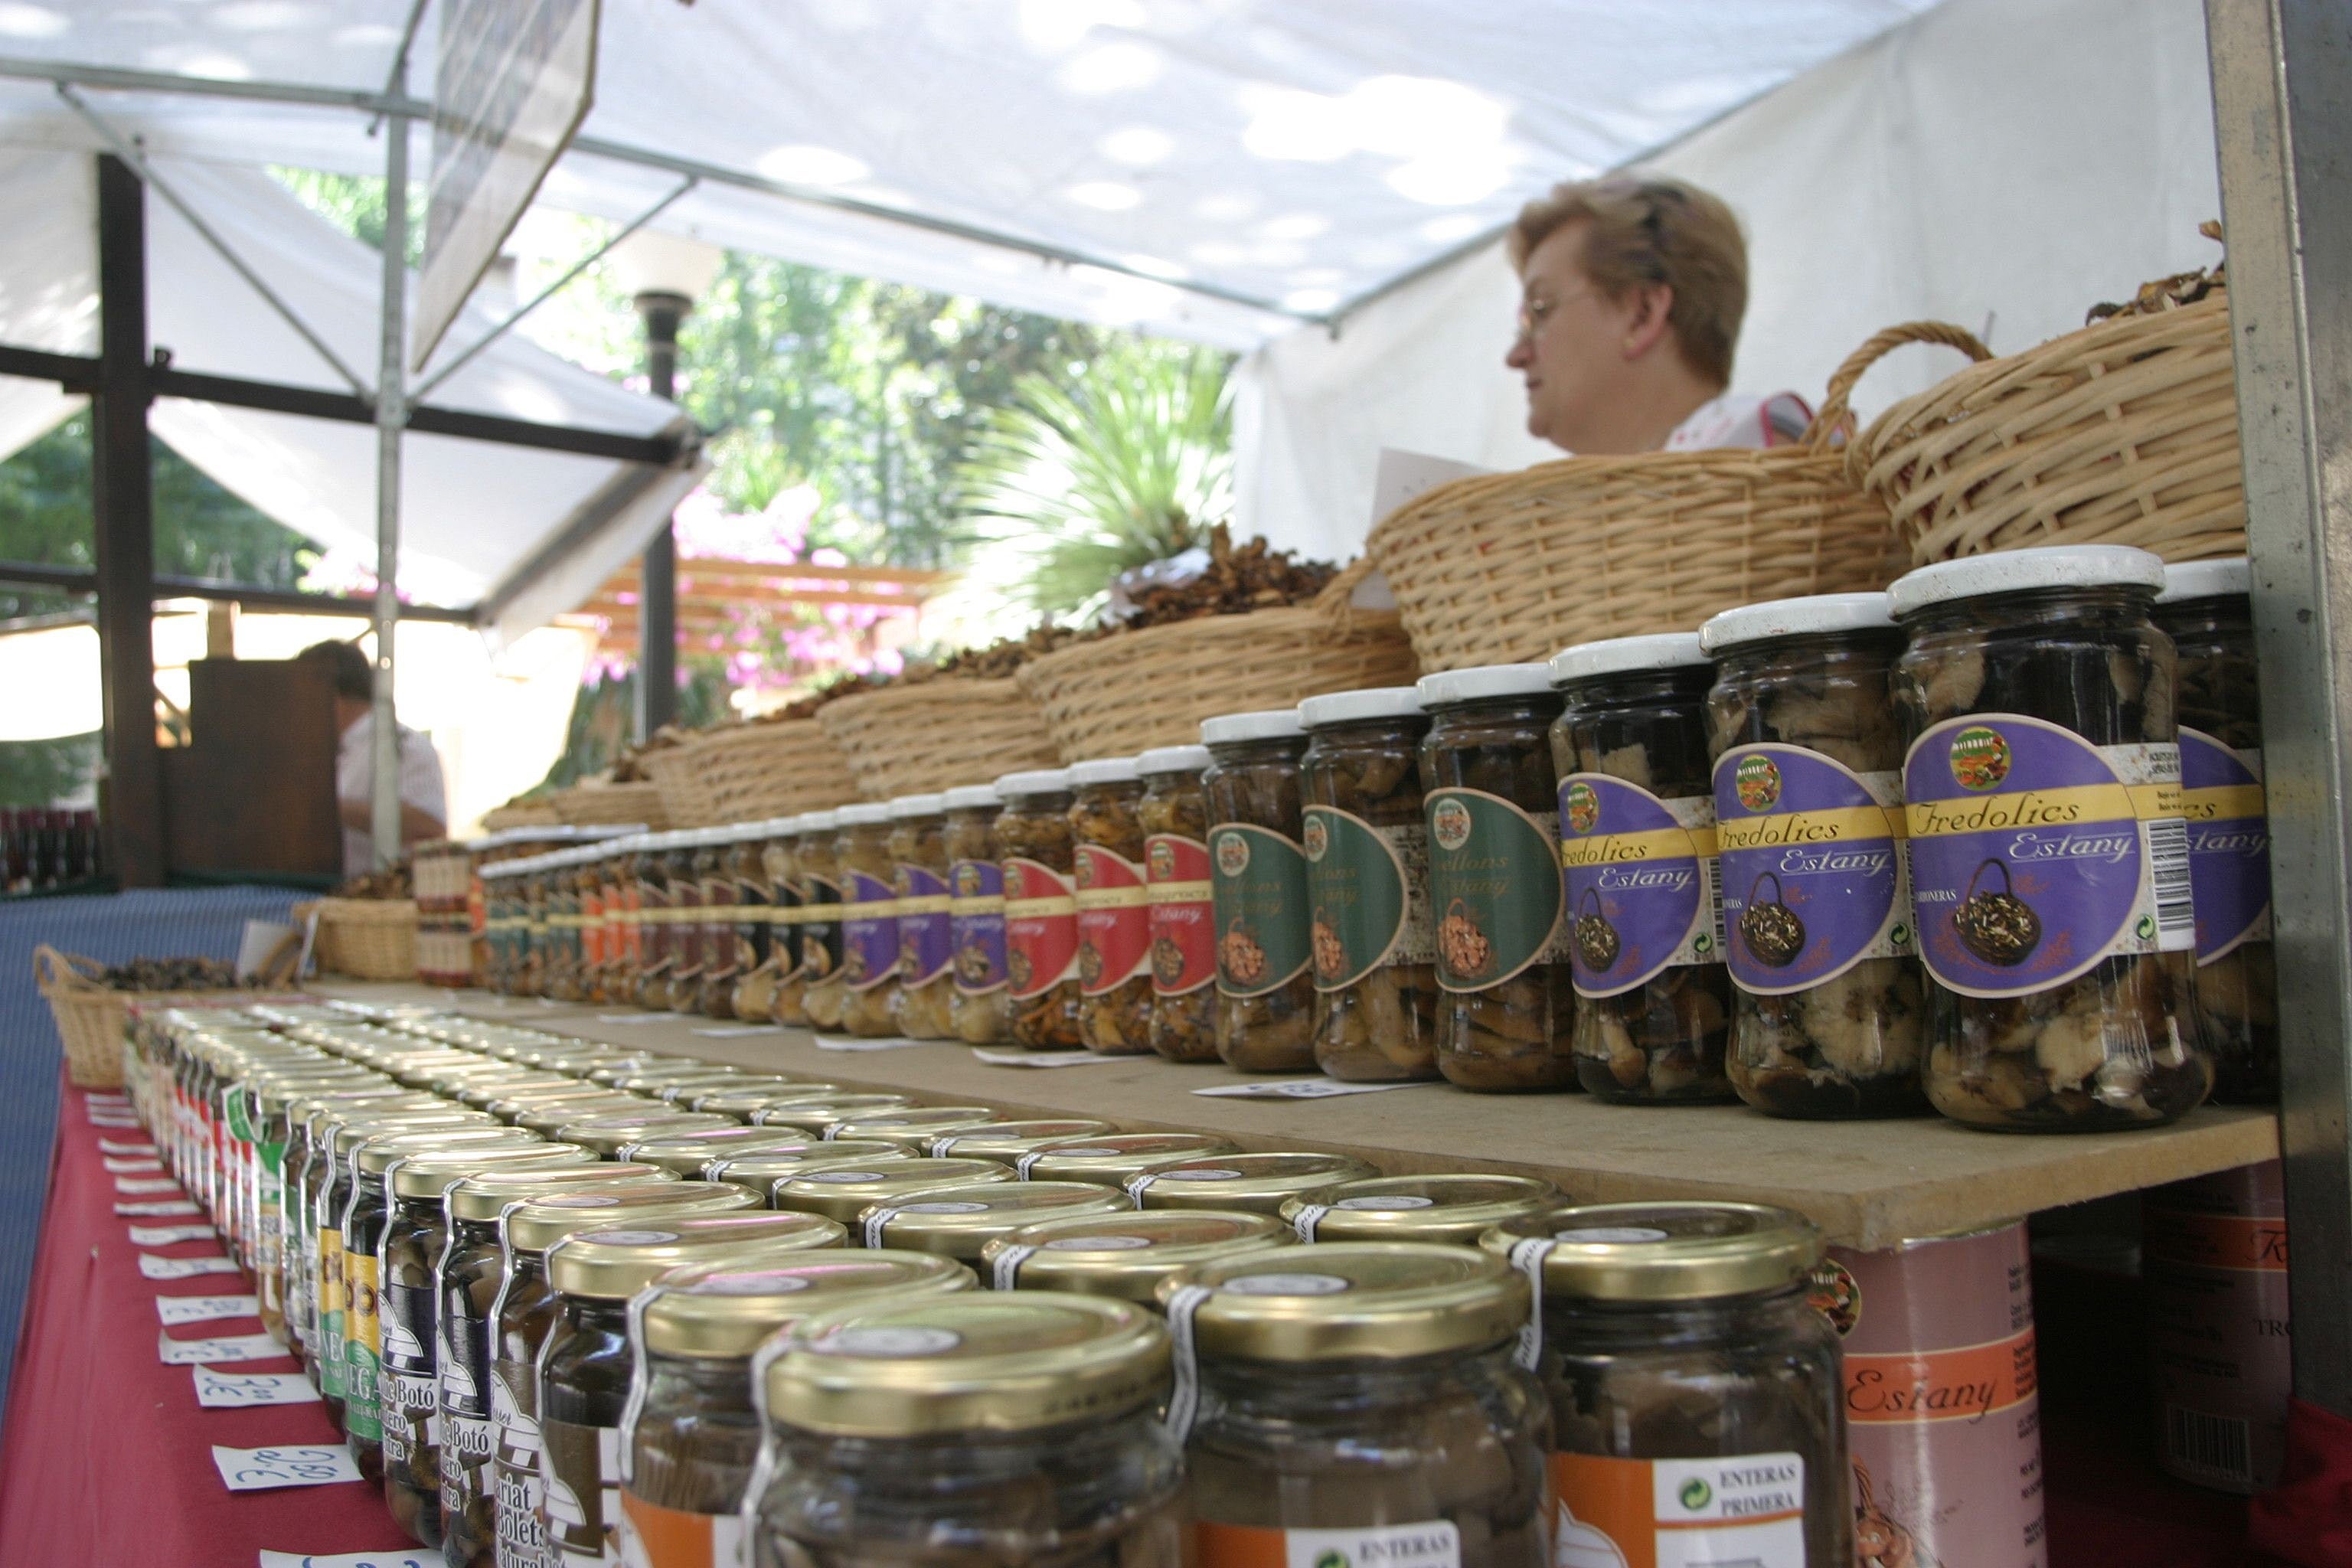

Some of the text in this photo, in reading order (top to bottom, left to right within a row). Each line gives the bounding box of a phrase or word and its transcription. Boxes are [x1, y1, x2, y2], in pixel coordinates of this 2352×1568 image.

[1916, 789, 2080, 833] Fredolics
[1563, 835, 1648, 865] redolics
[2009, 831, 2134, 863] Estany
[1779, 849, 1890, 877] Estany
[1599, 867, 1693, 892] Estany
[397, 1379, 434, 1407] Botó
[1847, 1369, 1998, 1425] Estany
[452, 1419, 488, 1452] Botó
[1720, 1464, 1796, 1488] ENTERAS
[1720, 1492, 1795, 1517] PRIMERA
[1360, 1530, 1452, 1562] ENTERAS
